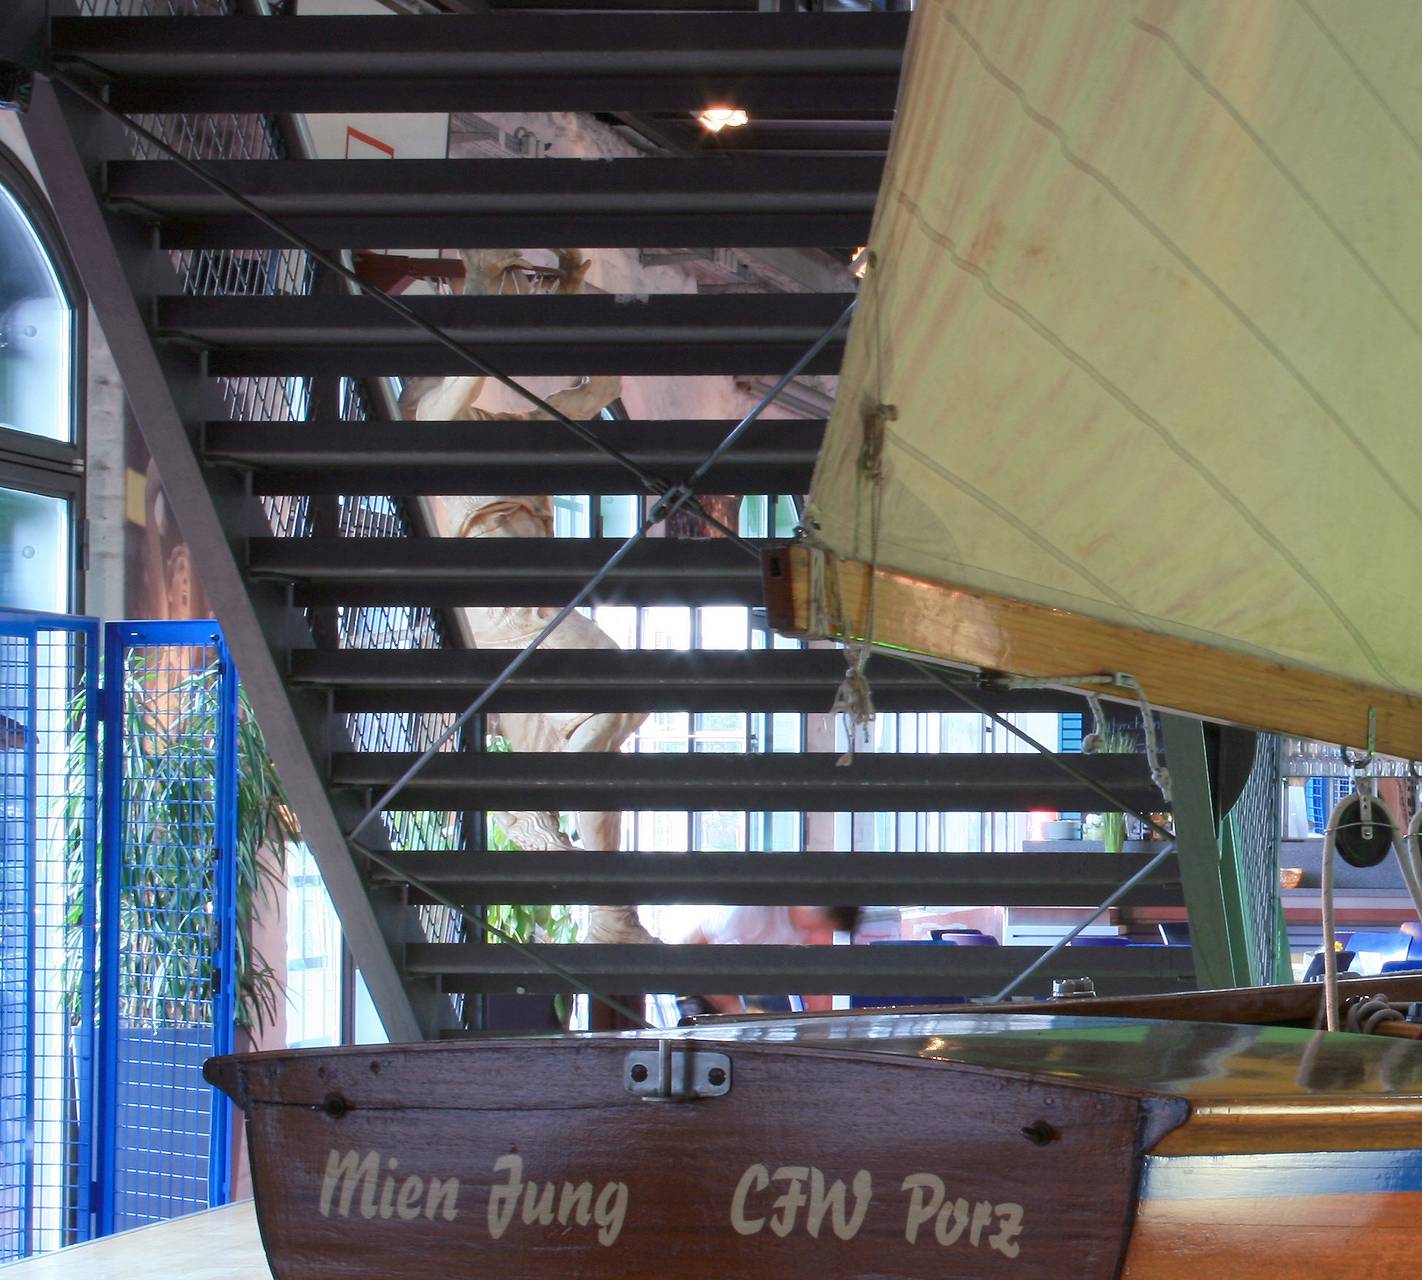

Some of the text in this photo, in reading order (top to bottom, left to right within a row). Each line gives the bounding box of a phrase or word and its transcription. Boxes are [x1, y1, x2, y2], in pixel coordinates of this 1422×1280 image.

[320, 1148, 1025, 1258] Mien Jung CFW Porz
